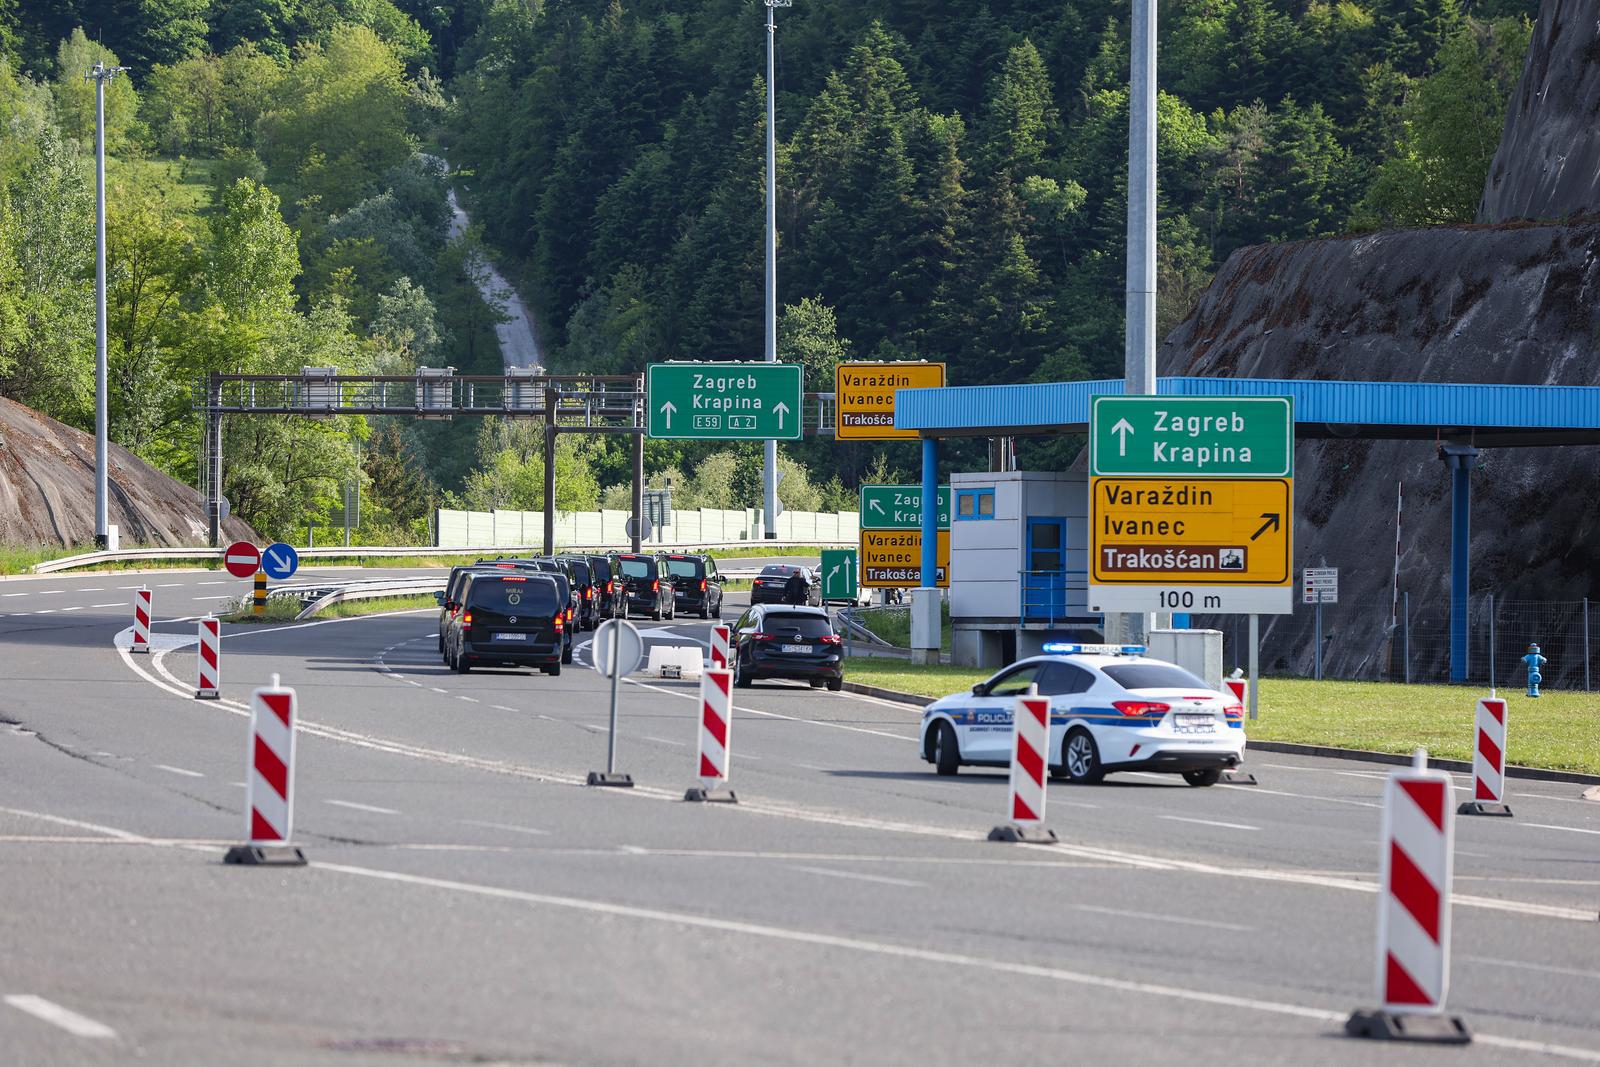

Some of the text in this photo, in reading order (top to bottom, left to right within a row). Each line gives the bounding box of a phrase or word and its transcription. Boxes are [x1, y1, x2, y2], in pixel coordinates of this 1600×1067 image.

[693, 374, 757, 393] Zagreb
[842, 374, 909, 386] Varaždin
[693, 394, 762, 412] Krapina
[843, 392, 893, 405] Ivanec
[697, 417, 717, 427] E 59
[734, 417, 751, 427] A 2
[842, 414, 894, 425] Trakošća
[1153, 411, 1245, 437] Zagreb
[1153, 442, 1253, 468] Krapina
[894, 493, 943, 508] Zagb
[1105, 485, 1213, 506] Varaždin
[894, 510, 947, 525] Krapa
[1104, 515, 1185, 536] Ivanec
[867, 534, 922, 546] Varaždi
[867, 551, 912, 562] Ivanec
[1103, 548, 1215, 569] Trakošćan
[867, 568, 921, 580] Trakošća
[1159, 591, 1221, 609] 100 m
